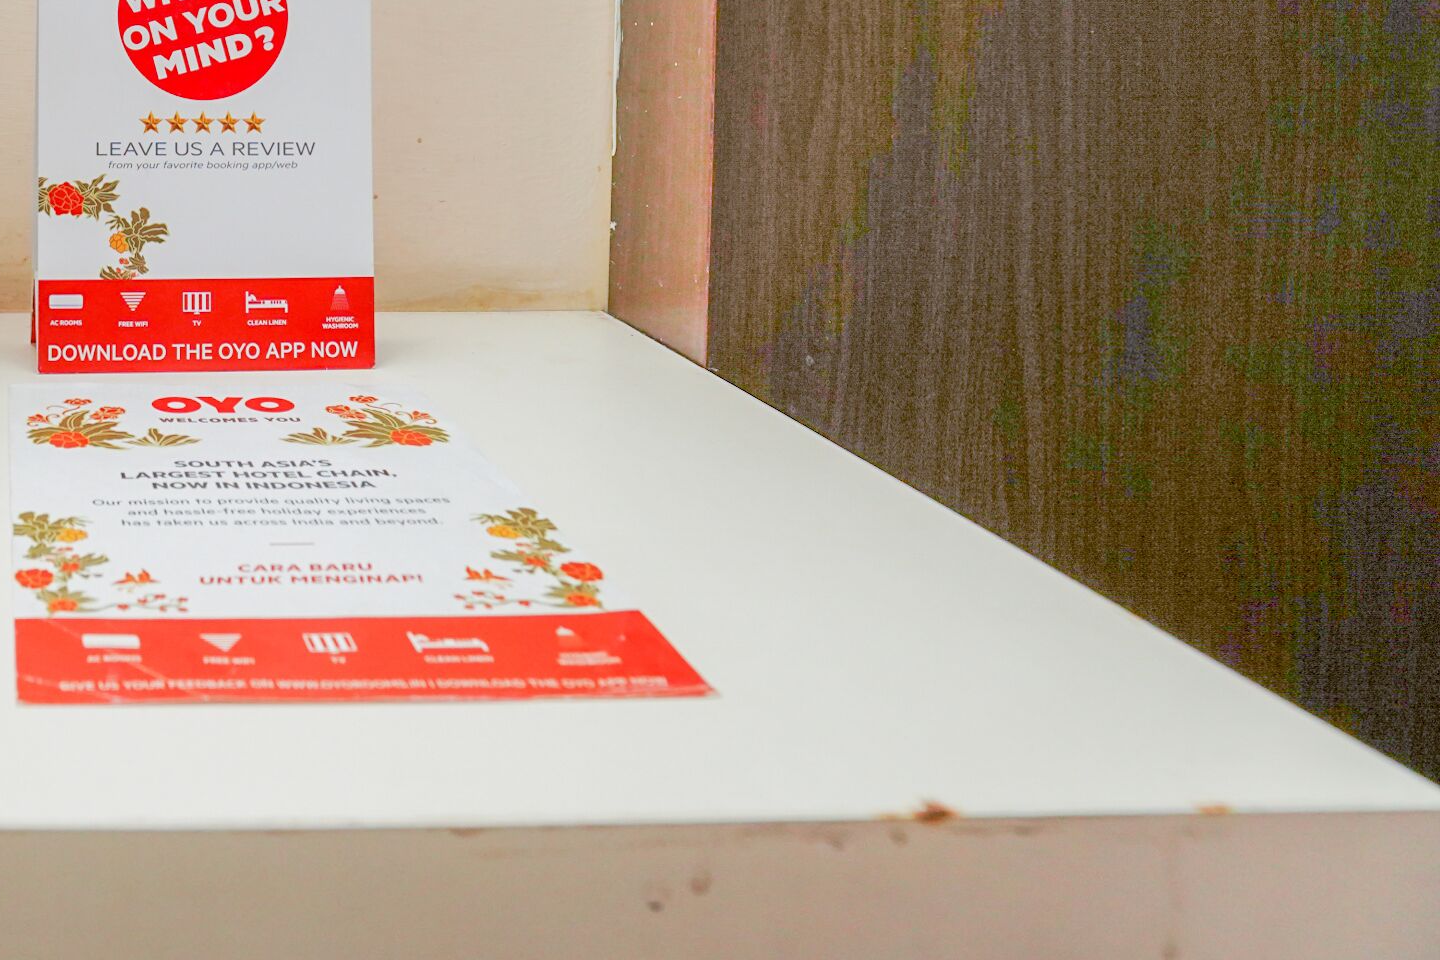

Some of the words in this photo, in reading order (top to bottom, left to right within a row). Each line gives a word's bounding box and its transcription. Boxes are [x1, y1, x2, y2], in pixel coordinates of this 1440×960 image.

[122, 15, 178, 51] ON
[96, 141, 168, 156] LEAVE
[174, 141, 203, 156] US
[209, 141, 225, 156] A
[232, 141, 316, 156] REVIEW
[108, 160, 133, 169] from
[136, 162, 160, 171] your
[163, 160, 204, 170] favorite
[206, 160, 249, 171] booking
[251, 160, 298, 171] app/web
[47, 343, 167, 362] DOWNLOAD
[171, 343, 213, 361] THE
[218, 342, 260, 360] OYO
[265, 342, 306, 359] APP
[311, 340, 358, 358] NOW
[151, 396, 295, 414] OYO
[173, 460, 255, 468] SOUTH
[260, 458, 332, 467] ASIA'S
[120, 470, 225, 479] LARGEST
[232, 470, 311, 479] HOTEL
[315, 469, 398, 479] CHAIN,
[151, 481, 208, 490] NOW
[215, 481, 239, 490] IN
[245, 480, 376, 490] INDONESIA
[92, 498, 122, 506] Our
[128, 498, 190, 506] mission
[195, 498, 212, 506] to
[217, 497, 280, 507] provide
[284, 497, 340, 506] quality
[345, 496, 391, 506] living
[395, 497, 451, 506] spaces
[128, 508, 158, 516] and
[163, 507, 257, 516] hassle-free
[260, 507, 321, 516] holiday
[327, 507, 427, 516] experiences
[121, 519, 151, 527] has
[156, 519, 204, 527] taken
[291, 518, 334, 526] India
[339, 518, 370, 526] and
[237, 563, 301, 573] CARA
[309, 562, 373, 572] BARU
[198, 576, 282, 585] UNTUK
